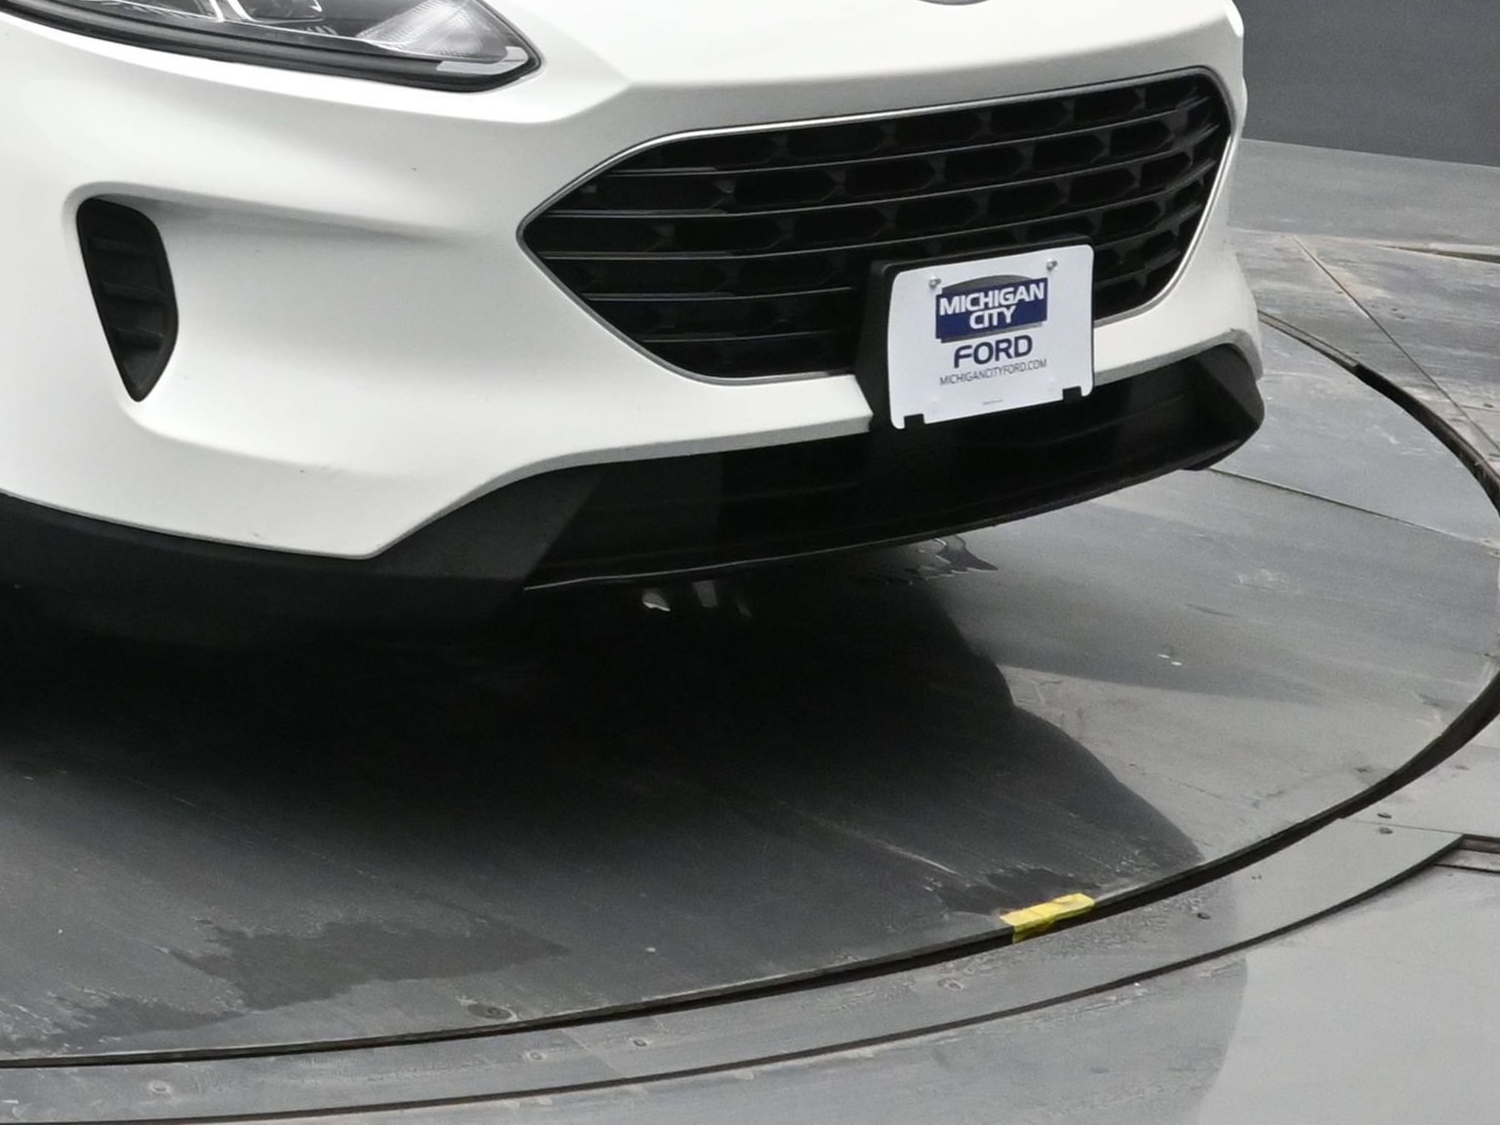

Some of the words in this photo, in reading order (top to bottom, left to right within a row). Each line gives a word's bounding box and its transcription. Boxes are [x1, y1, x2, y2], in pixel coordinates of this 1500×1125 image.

[939, 282, 1045, 316] MICHIGAN
[969, 305, 1017, 330] CITY
[953, 334, 1033, 369] FORD
[939, 358, 1048, 386] MICHIGANCITYFORD.COM
